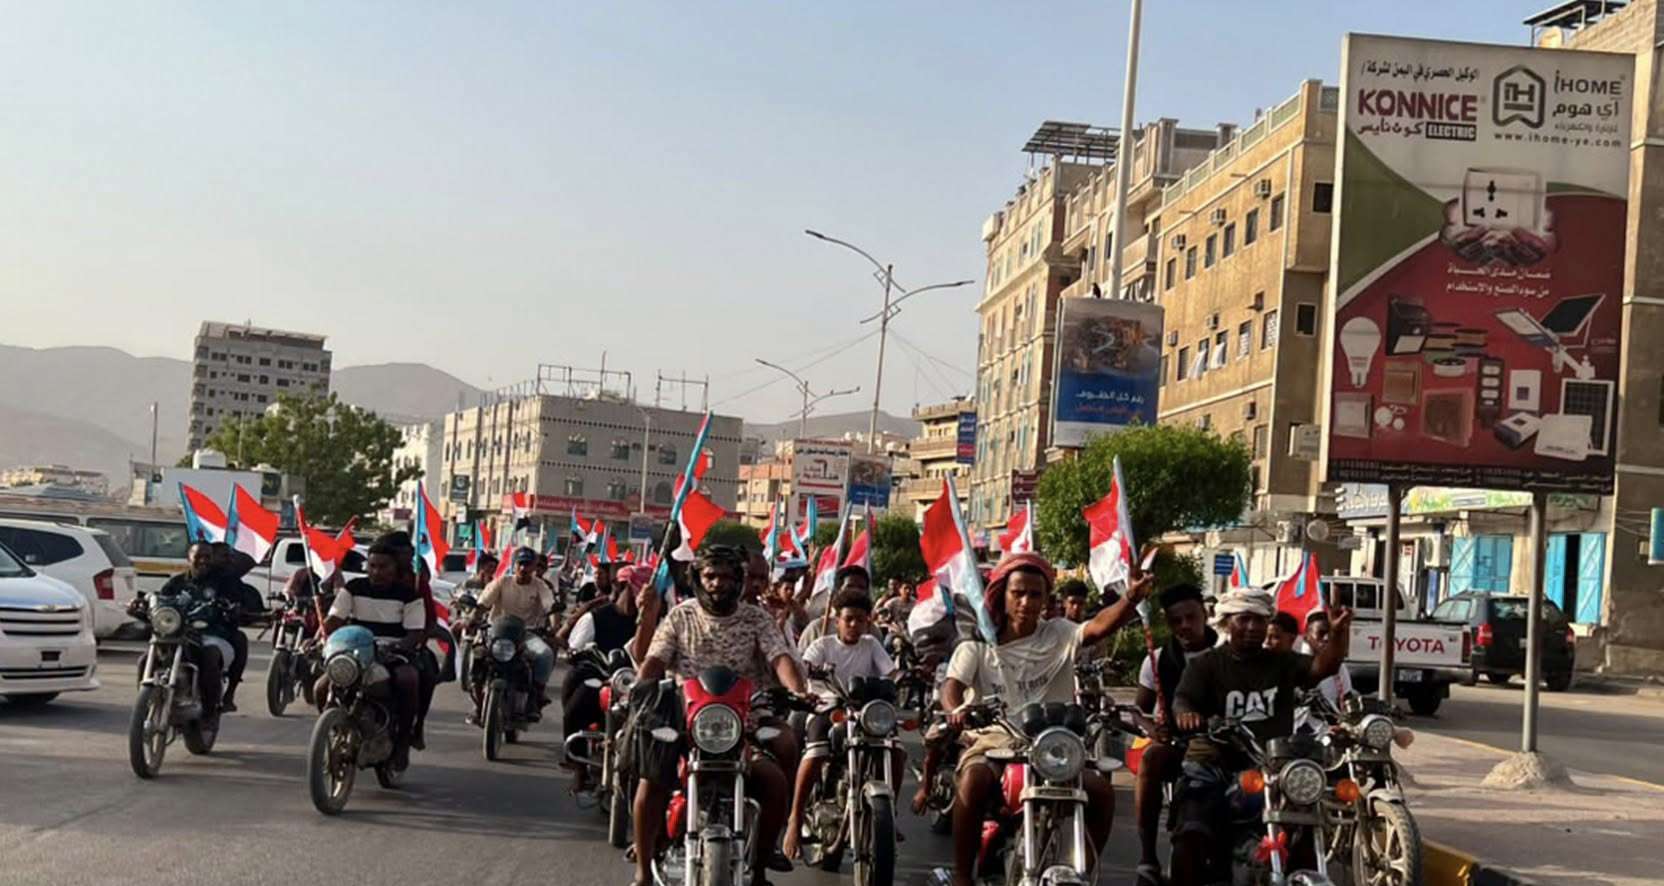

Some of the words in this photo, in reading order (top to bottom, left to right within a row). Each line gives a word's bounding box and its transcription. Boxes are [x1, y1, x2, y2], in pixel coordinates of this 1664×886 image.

[1455, 66, 1479, 82] الوكيل
[1554, 69, 1622, 95] iHOME
[1358, 88, 1478, 122] KONNICE
[1552, 103, 1592, 119] هوم
[1428, 123, 1475, 140] ELECTRIC
[1367, 636, 1445, 655] TYOTA
[1225, 685, 1278, 721] CAT
